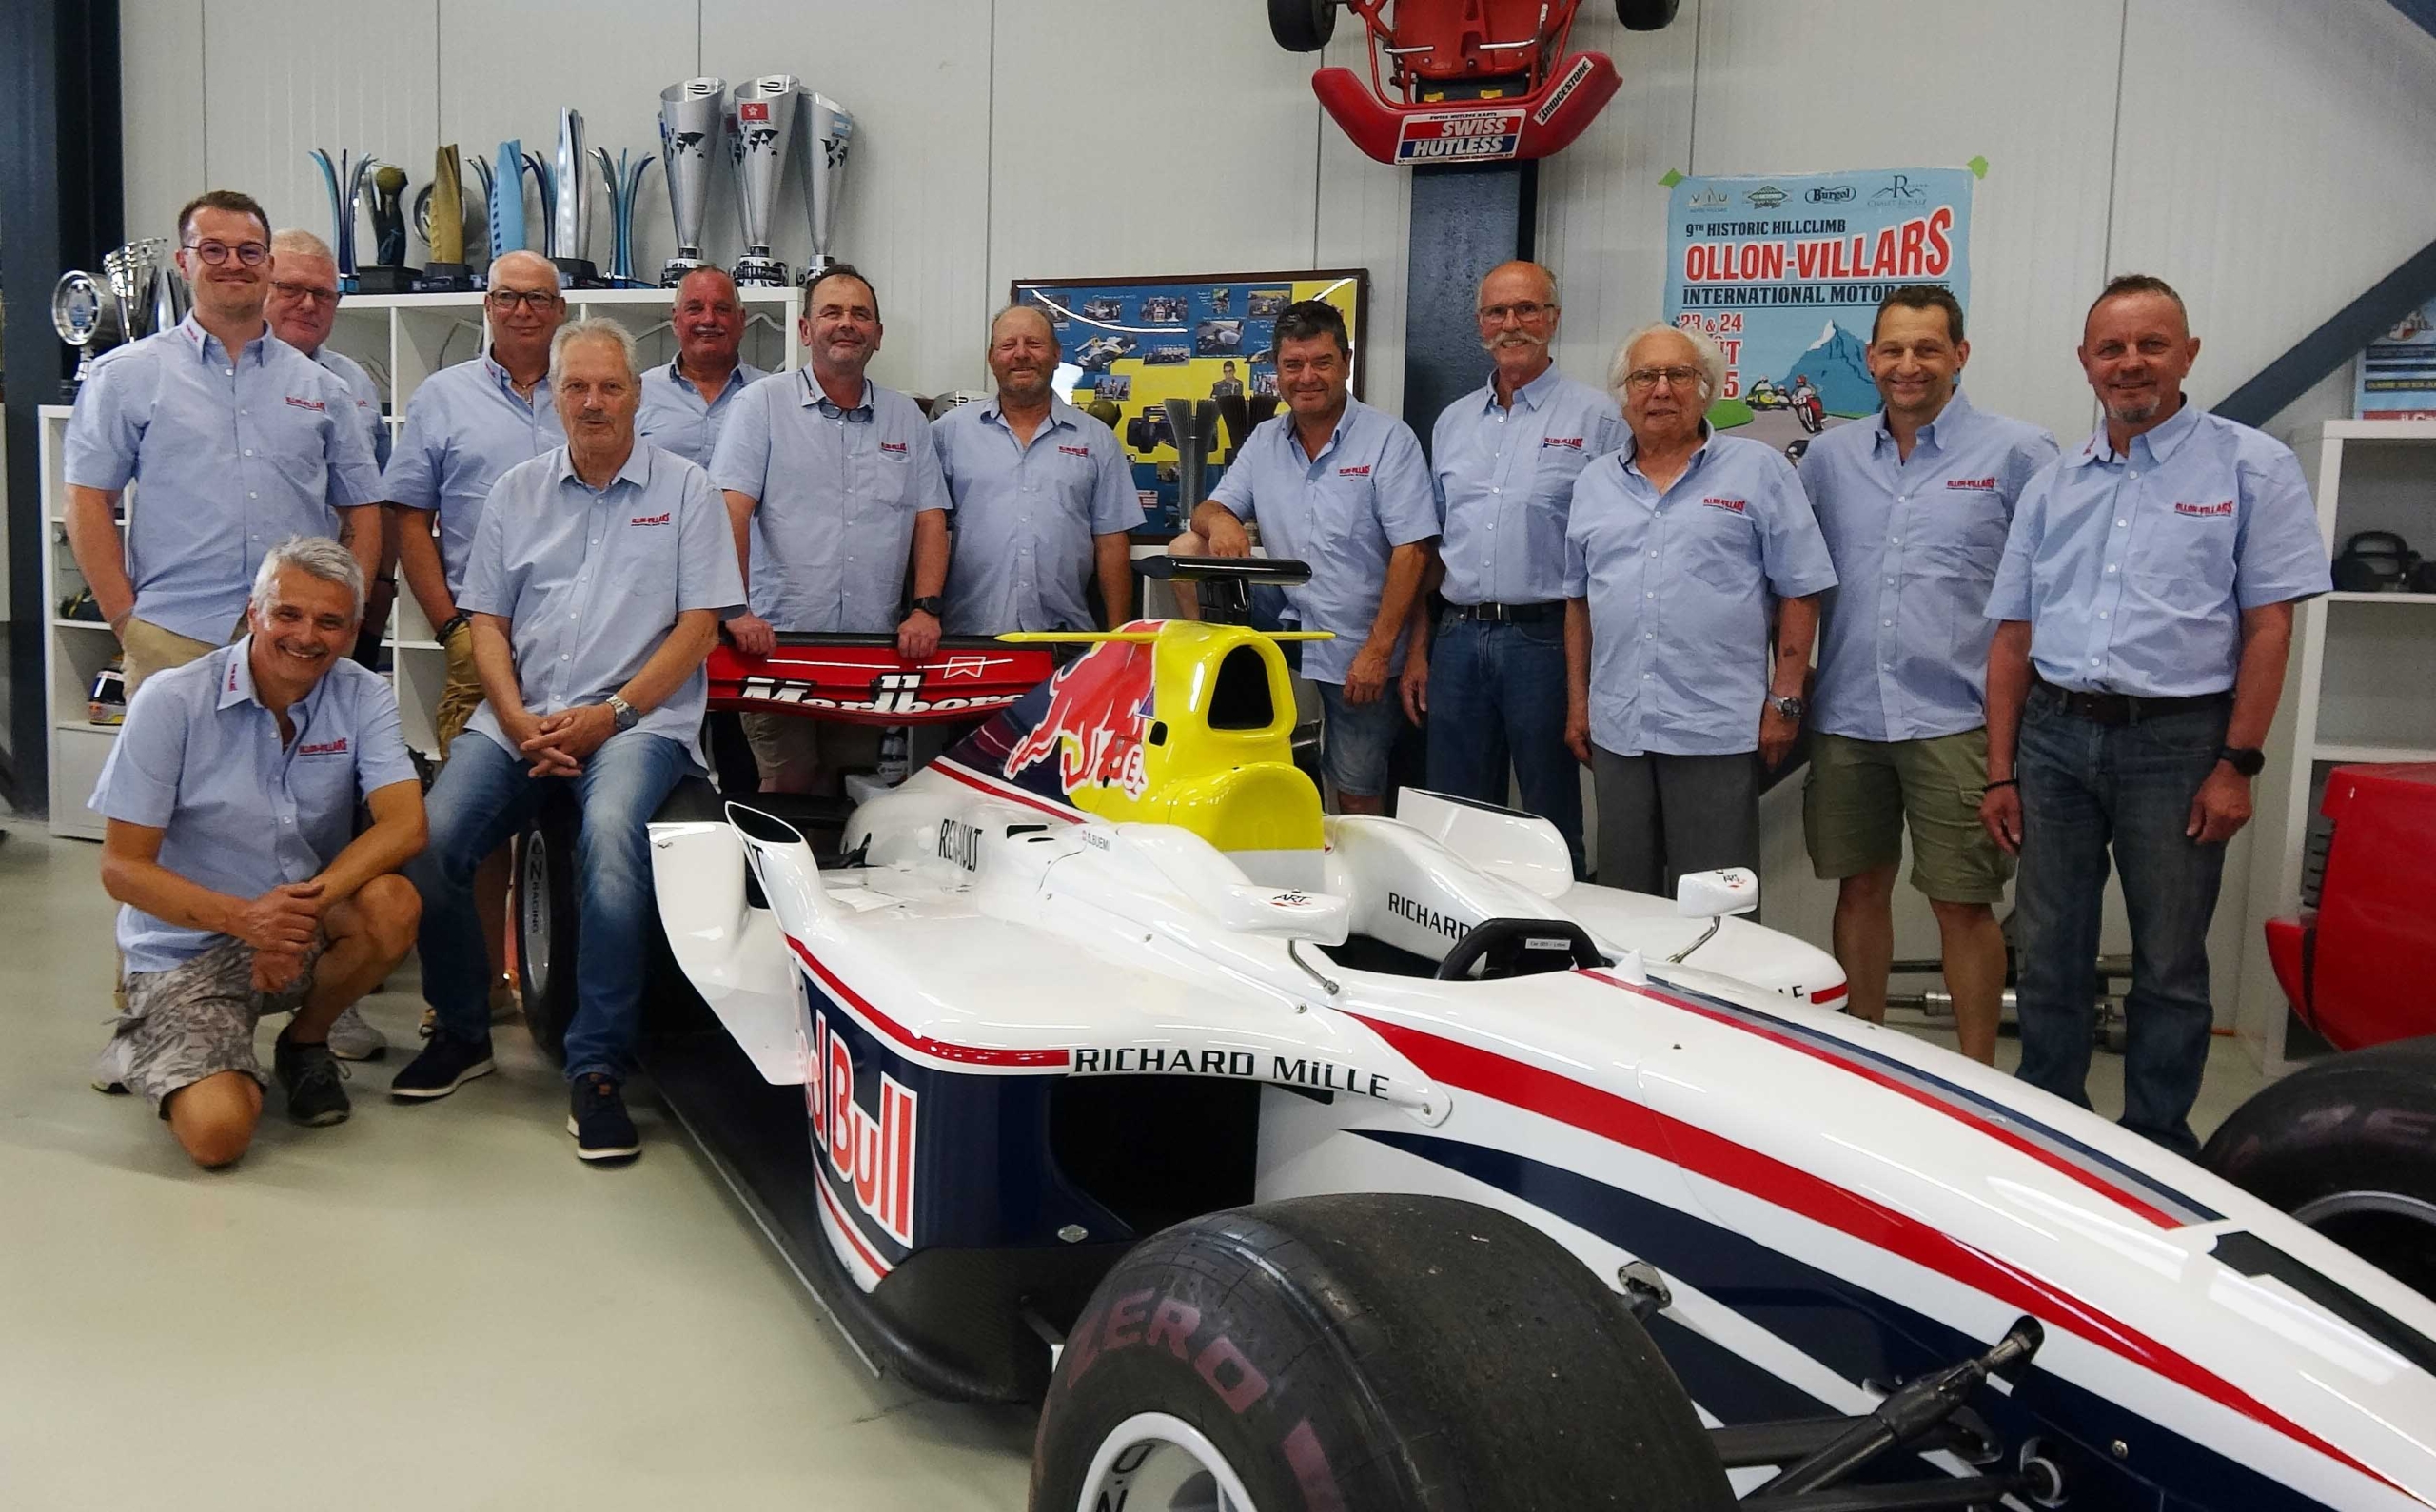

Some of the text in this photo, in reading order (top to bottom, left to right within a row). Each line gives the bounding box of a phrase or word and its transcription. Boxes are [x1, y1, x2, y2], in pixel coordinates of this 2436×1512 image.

[1538, 60, 1590, 123] BRIDGESTONE
[1441, 117, 1508, 137] SWISS
[1412, 136, 1504, 157] HUTLESS
[1685, 219, 1846, 237] 9TH HISTORIC HILLCLIMB
[1685, 208, 1953, 281] OLLON-VILLARS
[1682, 285, 1825, 305] INTERNATIONAL
[1705, 319, 1717, 333] &
[1719, 313, 1742, 333] 24
[1388, 892, 1472, 942] RICHARD
[1074, 1047, 1255, 1077] RICHARD
[829, 1029, 918, 1249] Bull
[1067, 1286, 1270, 1415] ZERO
